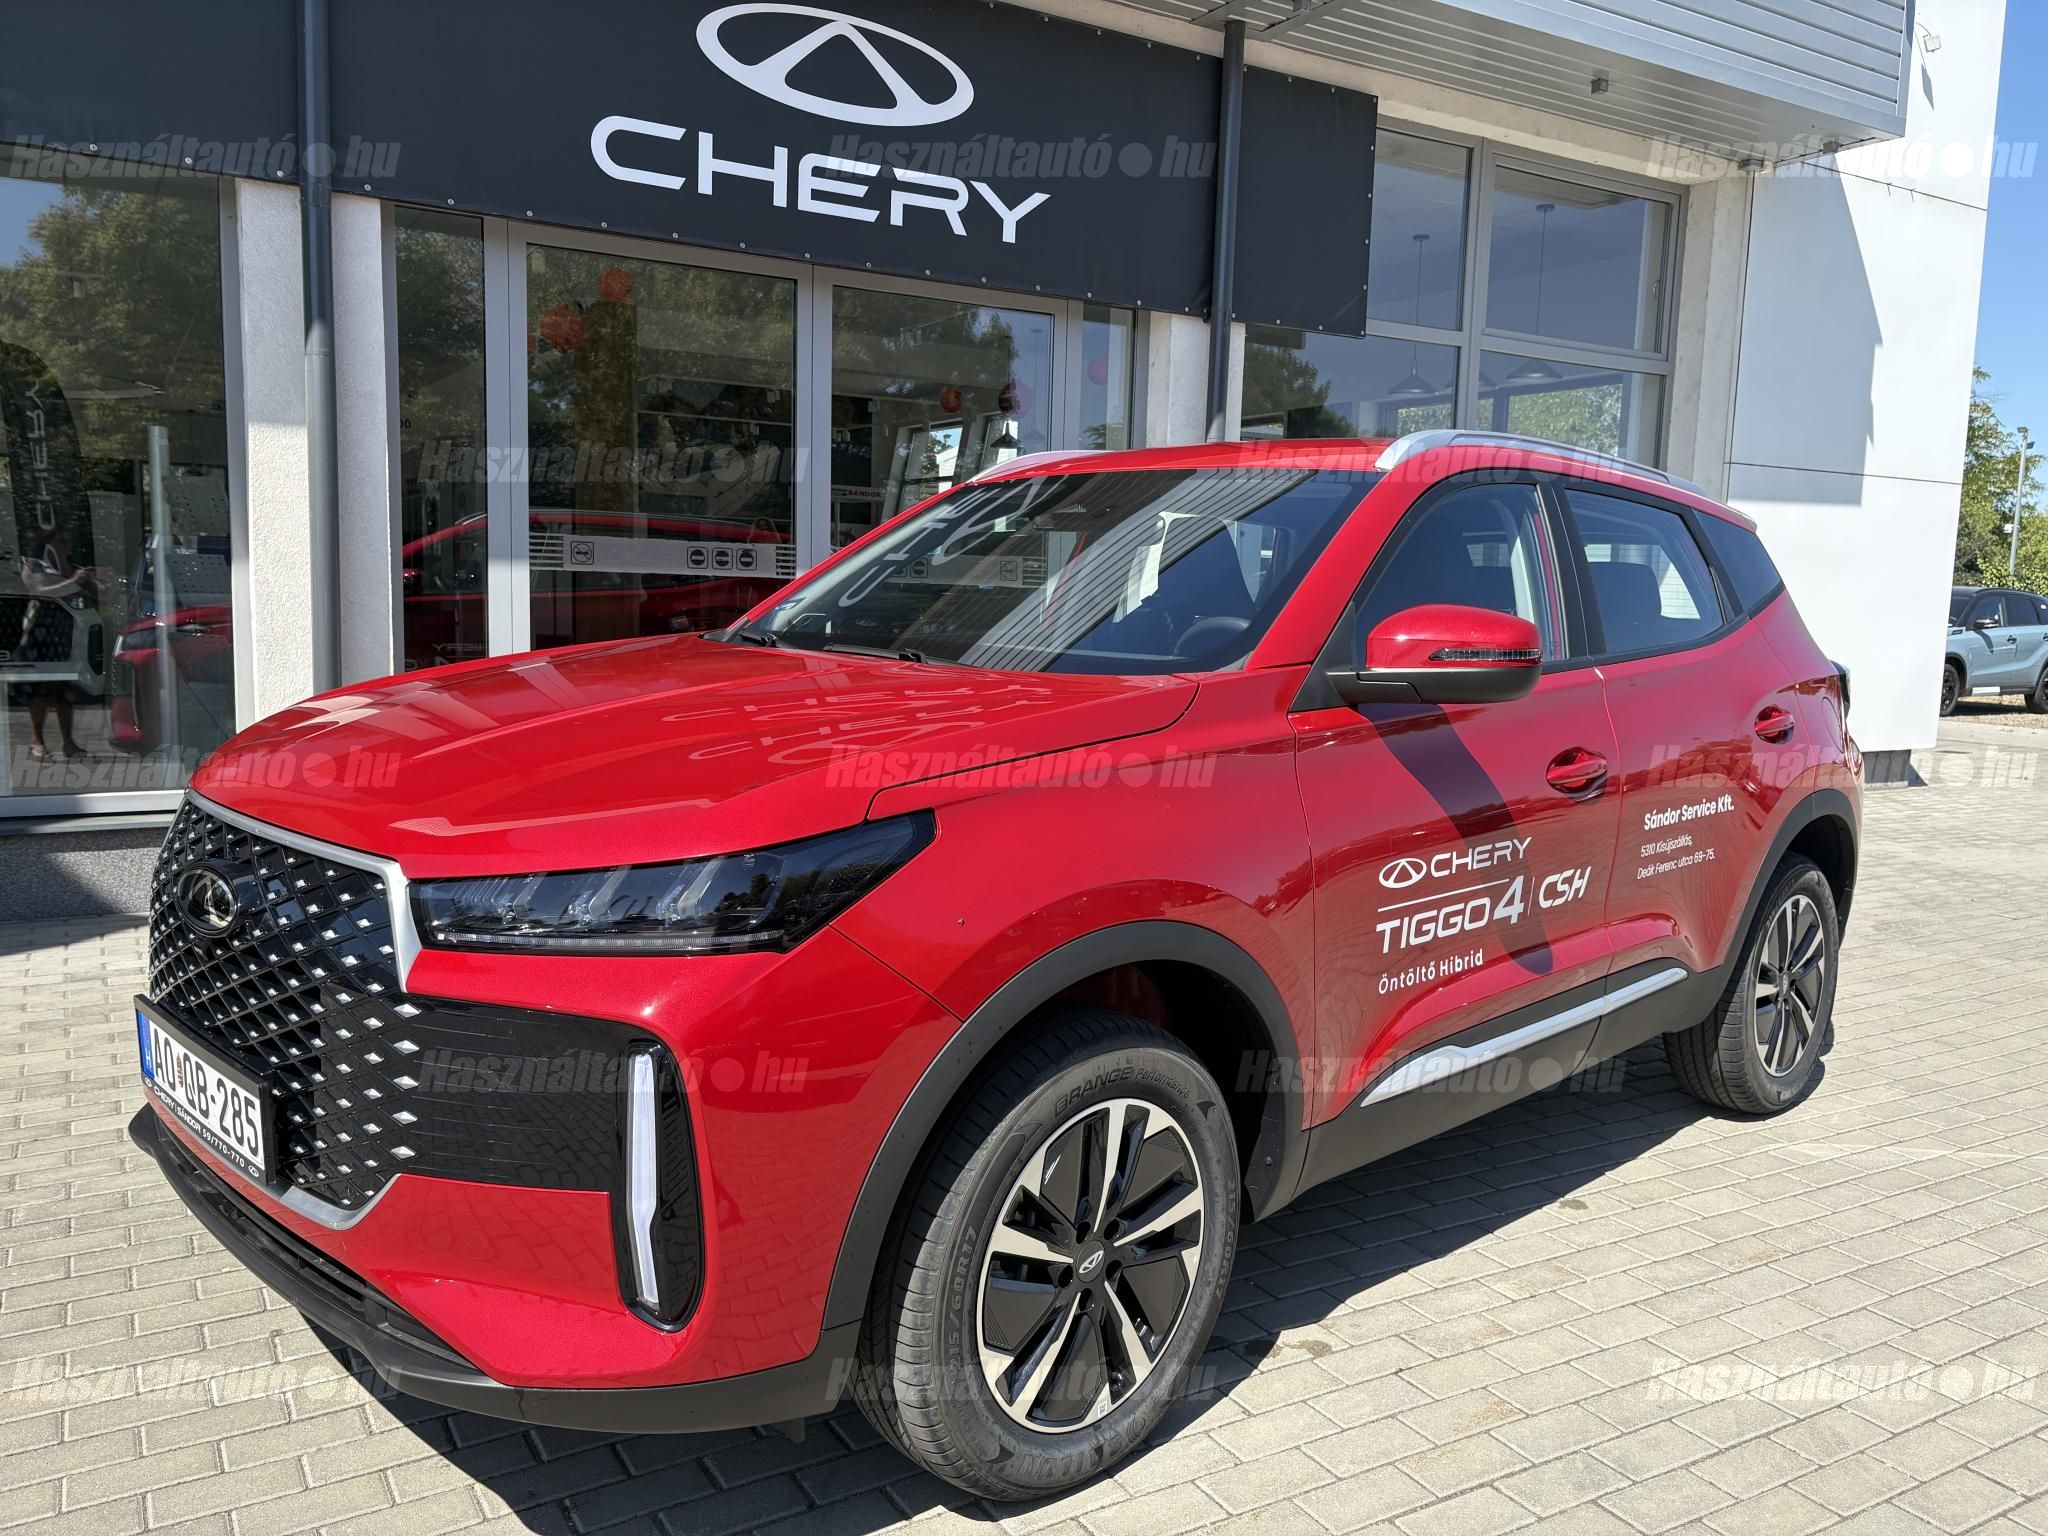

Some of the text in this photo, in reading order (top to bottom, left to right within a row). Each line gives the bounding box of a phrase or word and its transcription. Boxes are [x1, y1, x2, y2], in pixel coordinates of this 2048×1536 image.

[590, 115, 1051, 244] CHERY
[1644, 793, 1735, 831] Sándor Service Kft.
[1429, 836, 1532, 878] CHERY
[1637, 848, 1716, 880] Deák Ferenc utca 69-75.
[1538, 866, 1592, 910] CSH
[1378, 948, 1484, 996] Öntöltő Hibrid
